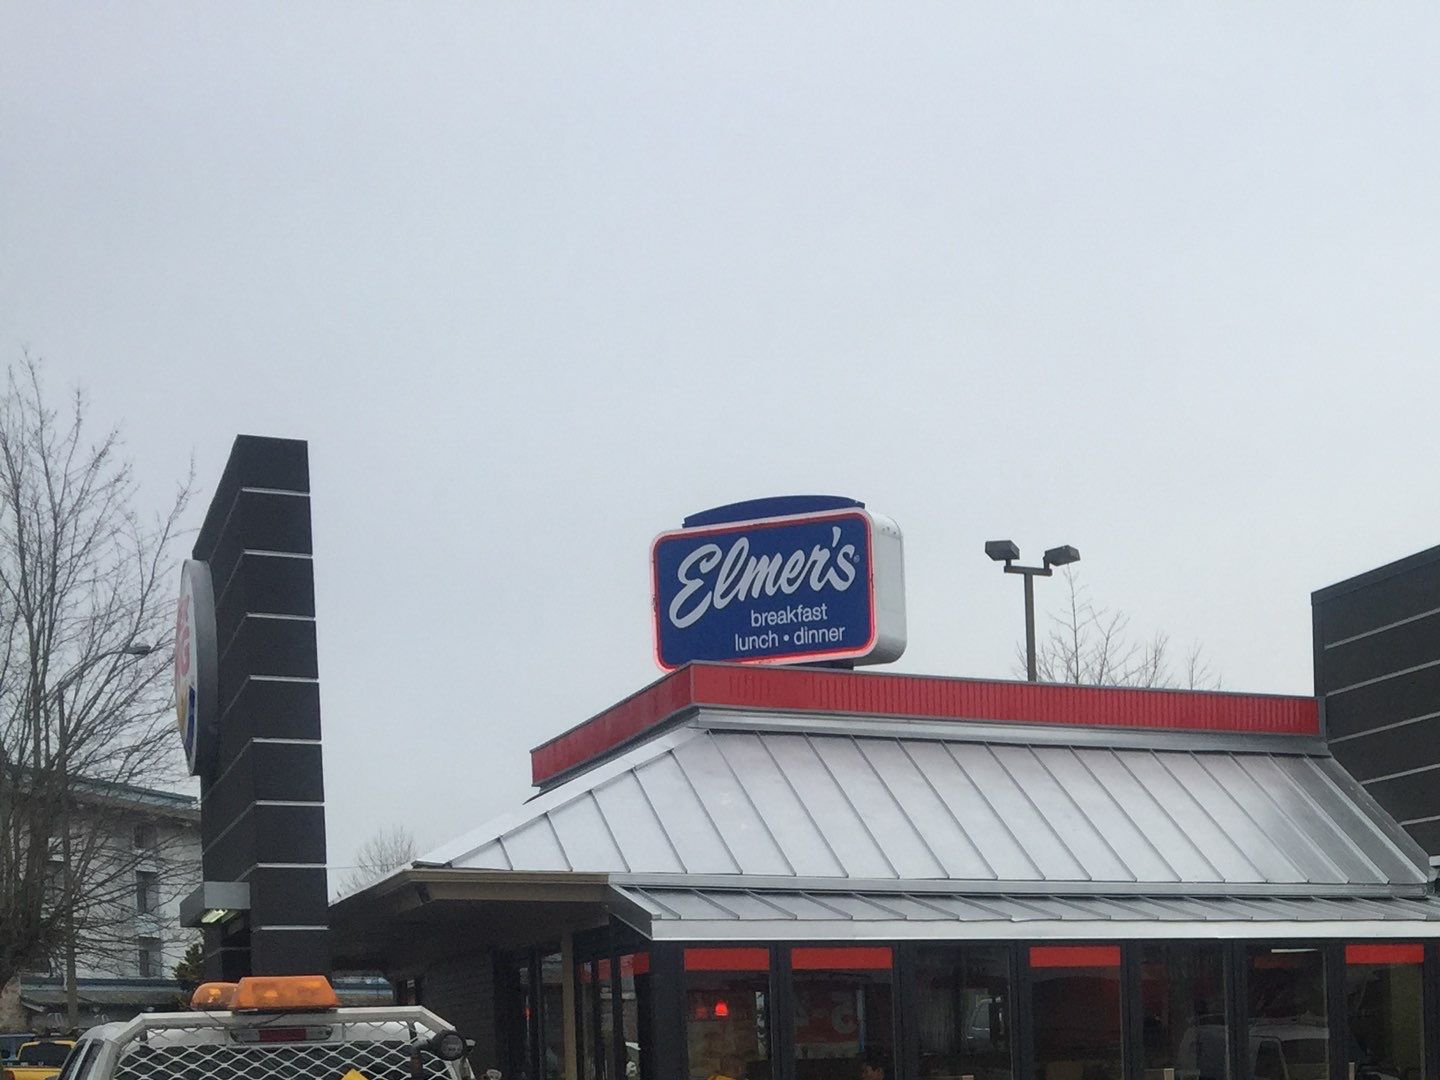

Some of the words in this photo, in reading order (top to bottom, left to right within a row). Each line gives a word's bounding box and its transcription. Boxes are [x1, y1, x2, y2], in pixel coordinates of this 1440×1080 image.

[668, 526, 858, 629] Elmer's
[750, 603, 828, 628] breakfast
[734, 630, 779, 651] lunch
[794, 626, 846, 645] dinner
